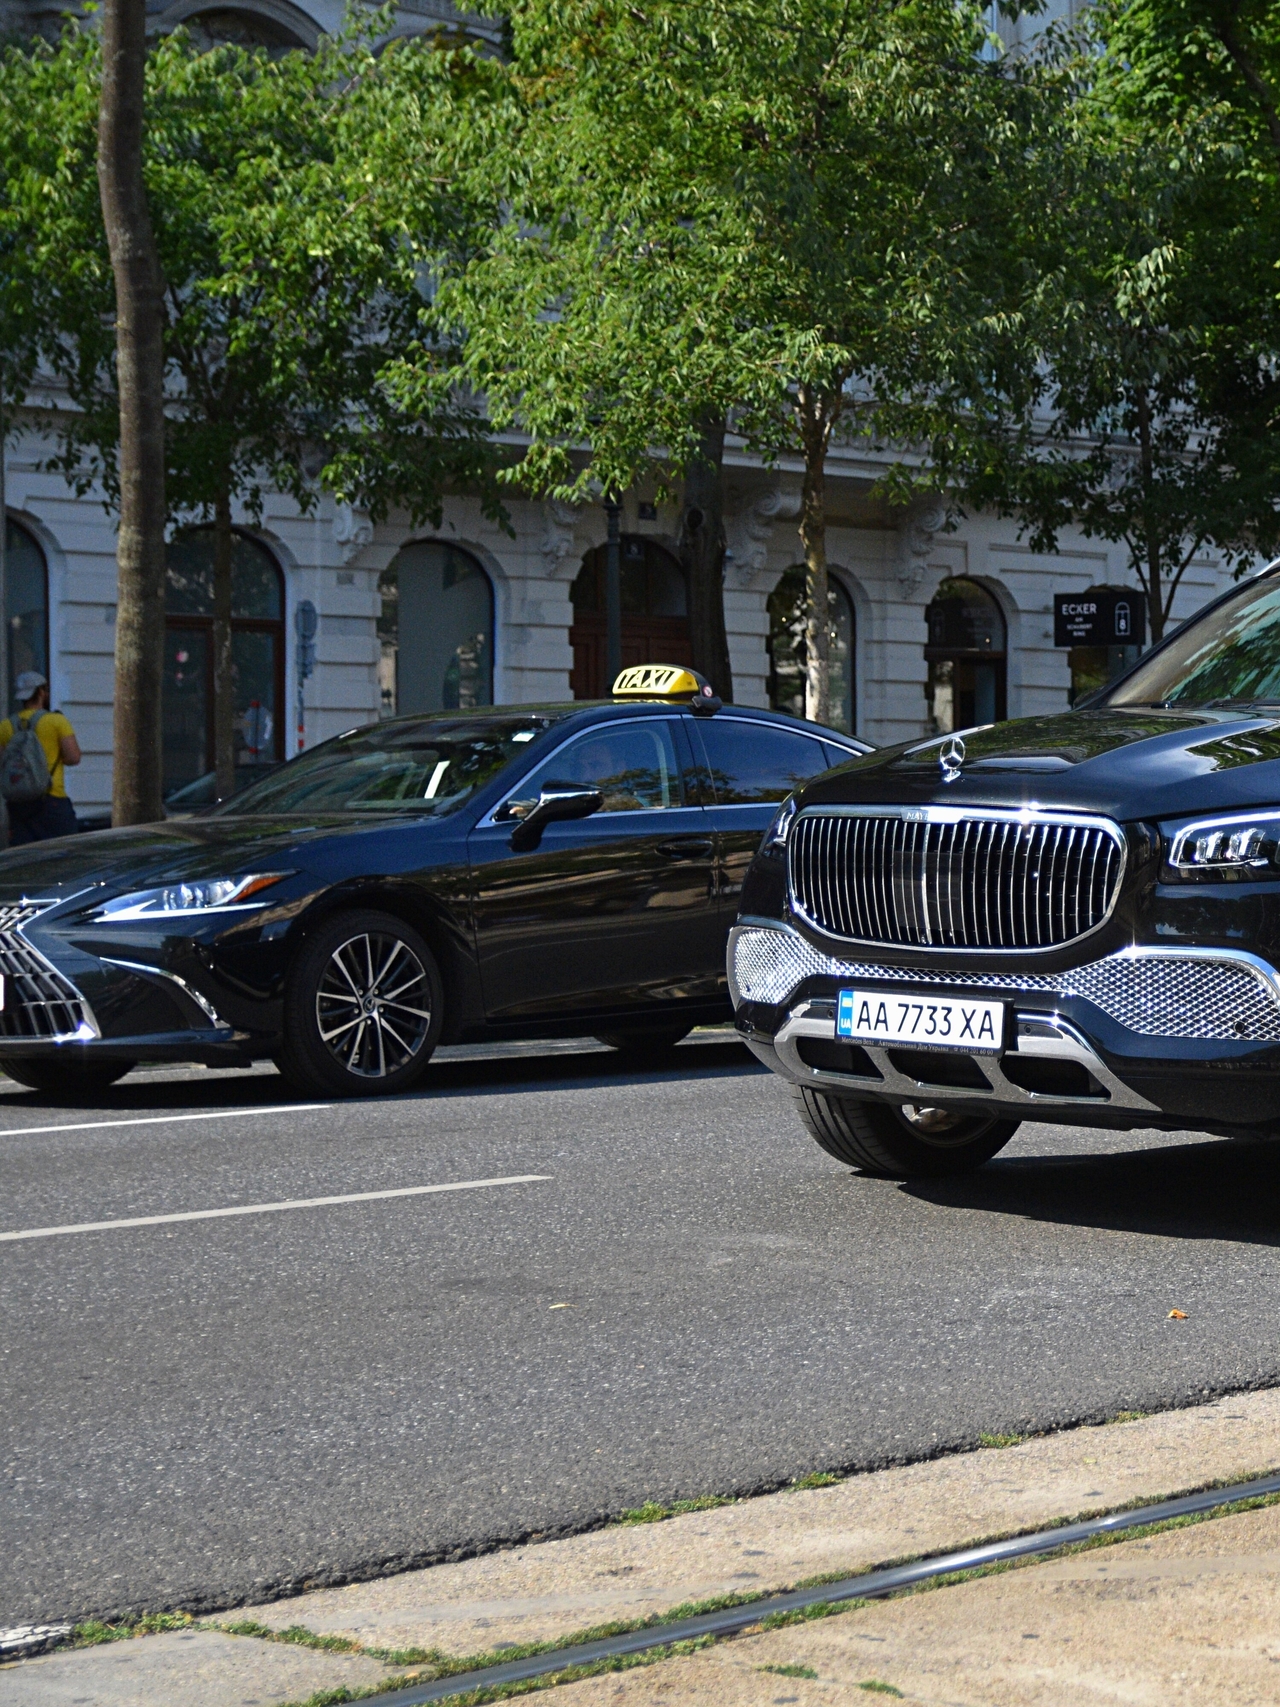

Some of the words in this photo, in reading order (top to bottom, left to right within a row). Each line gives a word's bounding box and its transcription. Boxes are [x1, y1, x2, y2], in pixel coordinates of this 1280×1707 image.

[1062, 603, 1097, 615] ECKER
[620, 669, 672, 688] TAXI
[840, 1018, 851, 1029] UA
[856, 1000, 888, 1032] AA
[897, 1003, 952, 1036] 7733
[959, 1008, 994, 1040] XA
